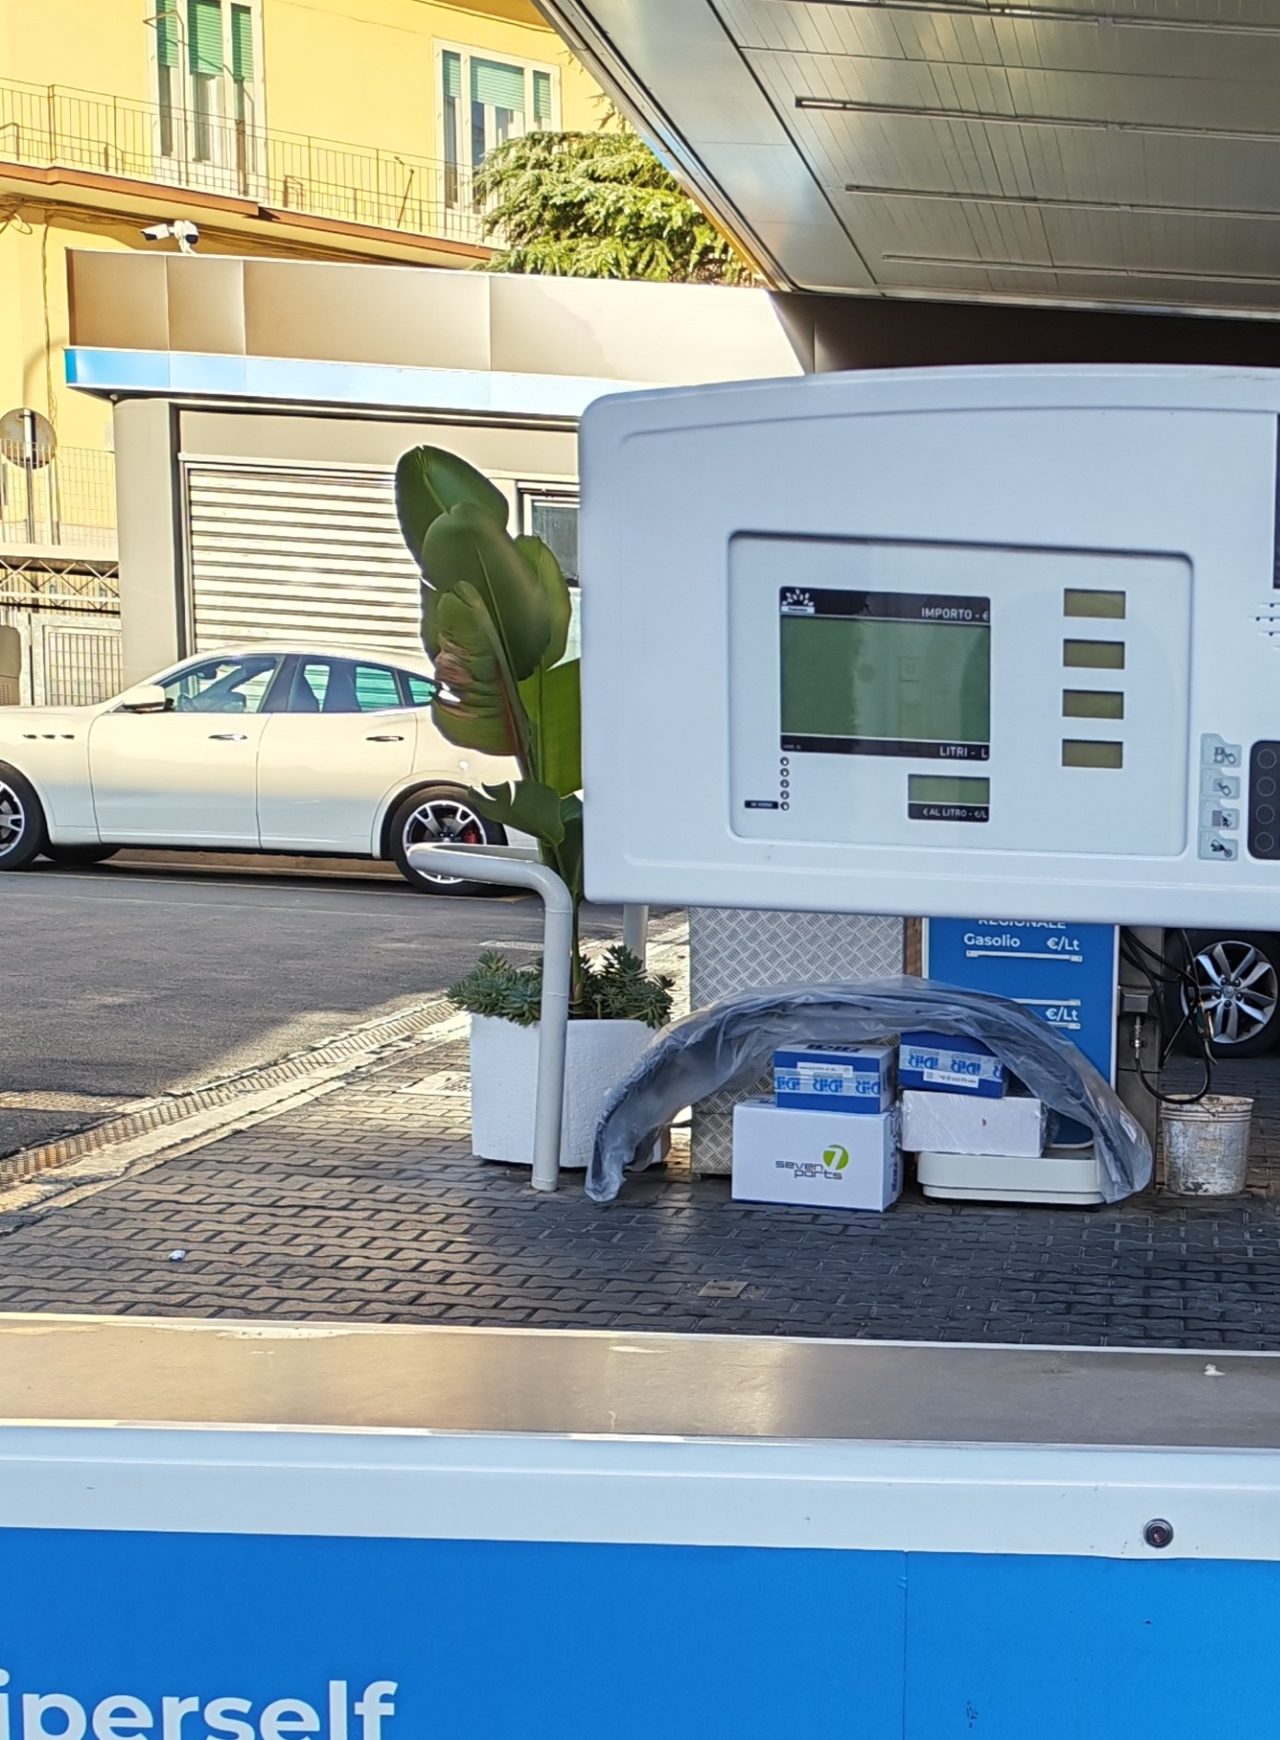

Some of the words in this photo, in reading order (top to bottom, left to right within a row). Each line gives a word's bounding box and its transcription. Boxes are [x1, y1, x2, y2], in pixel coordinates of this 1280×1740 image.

[921, 607, 972, 620] IMPORTO
[982, 611, 989, 621] €
[939, 746, 968, 758] LITRI
[981, 749, 988, 759] L
[929, 808, 941, 817] AL
[942, 808, 967, 819] LITRO
[964, 933, 1021, 948] Gasolio
[1046, 936, 1080, 951] €/Lt
[1045, 1007, 1079, 1022] €/Lt
[775, 1160, 824, 1171] seven
[794, 1169, 843, 1181] parts
